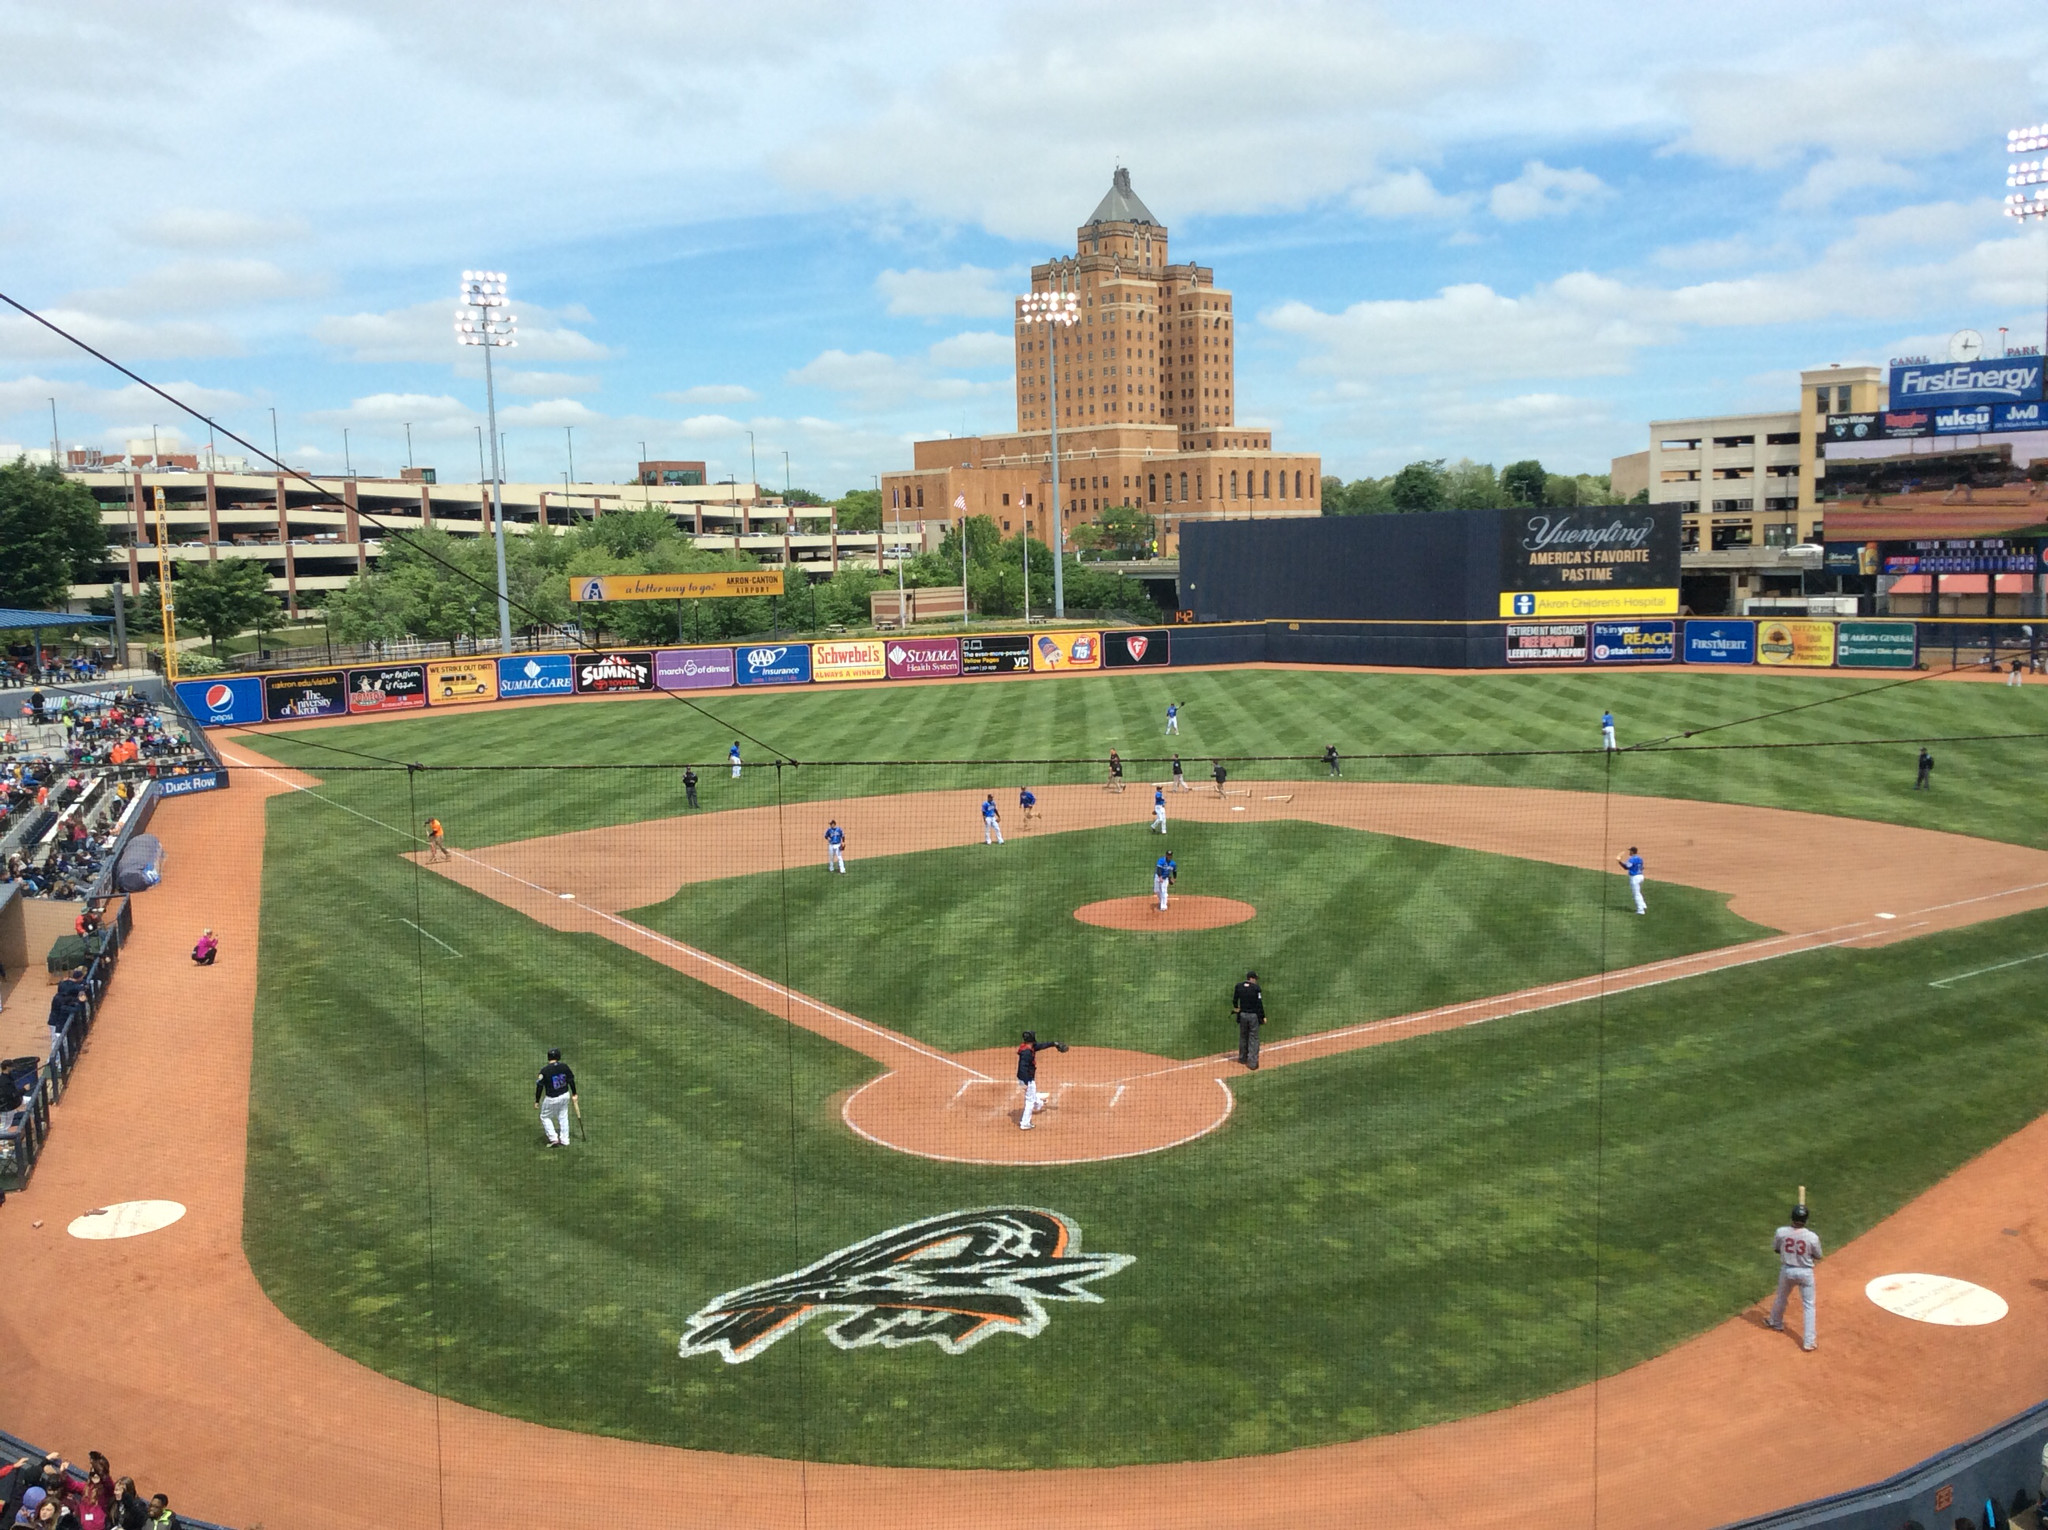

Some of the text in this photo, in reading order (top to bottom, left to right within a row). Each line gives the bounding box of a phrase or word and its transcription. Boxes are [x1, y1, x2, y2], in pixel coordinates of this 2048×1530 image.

[1890, 346, 2039, 367] CANAL PARK
[1901, 366, 2038, 393] FirstEnergy
[1829, 415, 1875, 425] Dave Walter
[1935, 409, 1990, 427] wksu
[157, 502, 167, 541] PARK
[1522, 516, 1655, 551] Yuengling
[1529, 549, 1650, 565] AMERICA'S FAVORITE
[162, 546, 172, 600] SUBARU
[1561, 567, 1613, 581] PASTIME
[625, 585, 633, 594] a
[635, 580, 663, 593] better
[665, 585, 685, 595] way
[688, 582, 698, 592] to
[736, 586, 770, 594] AIRPORT
[1538, 596, 1666, 609] Akron Children's Hospital
[1508, 625, 1587, 636] RETIREMENT MISTAKES?
[1596, 625, 1639, 636] It's in your
[1623, 633, 1673, 645] REACH
[1880, 634, 1914, 642] GENERAL
[818, 645, 880, 665] Schwebel's
[906, 649, 958, 663] SUMMA
[1074, 646, 1088, 660] 75
[1610, 647, 1673, 655] starkstate.edu
[907, 663, 958, 672] Health System
[1014, 656, 1029, 668] yp
[381, 669, 420, 680] Our Passion
[582, 664, 648, 686] SUMMIT
[658, 666, 685, 675] march
[706, 665, 730, 673] dimes
[762, 667, 800, 676] Insurance
[815, 670, 843, 679] ALWAYS
[386, 681, 392, 690] is
[303, 690, 321, 700] The
[281, 703, 292, 715] of
[210, 713, 234, 723] pepsi
[165, 777, 216, 794] Duck Row
[1784, 1238, 1806, 1256] 23
